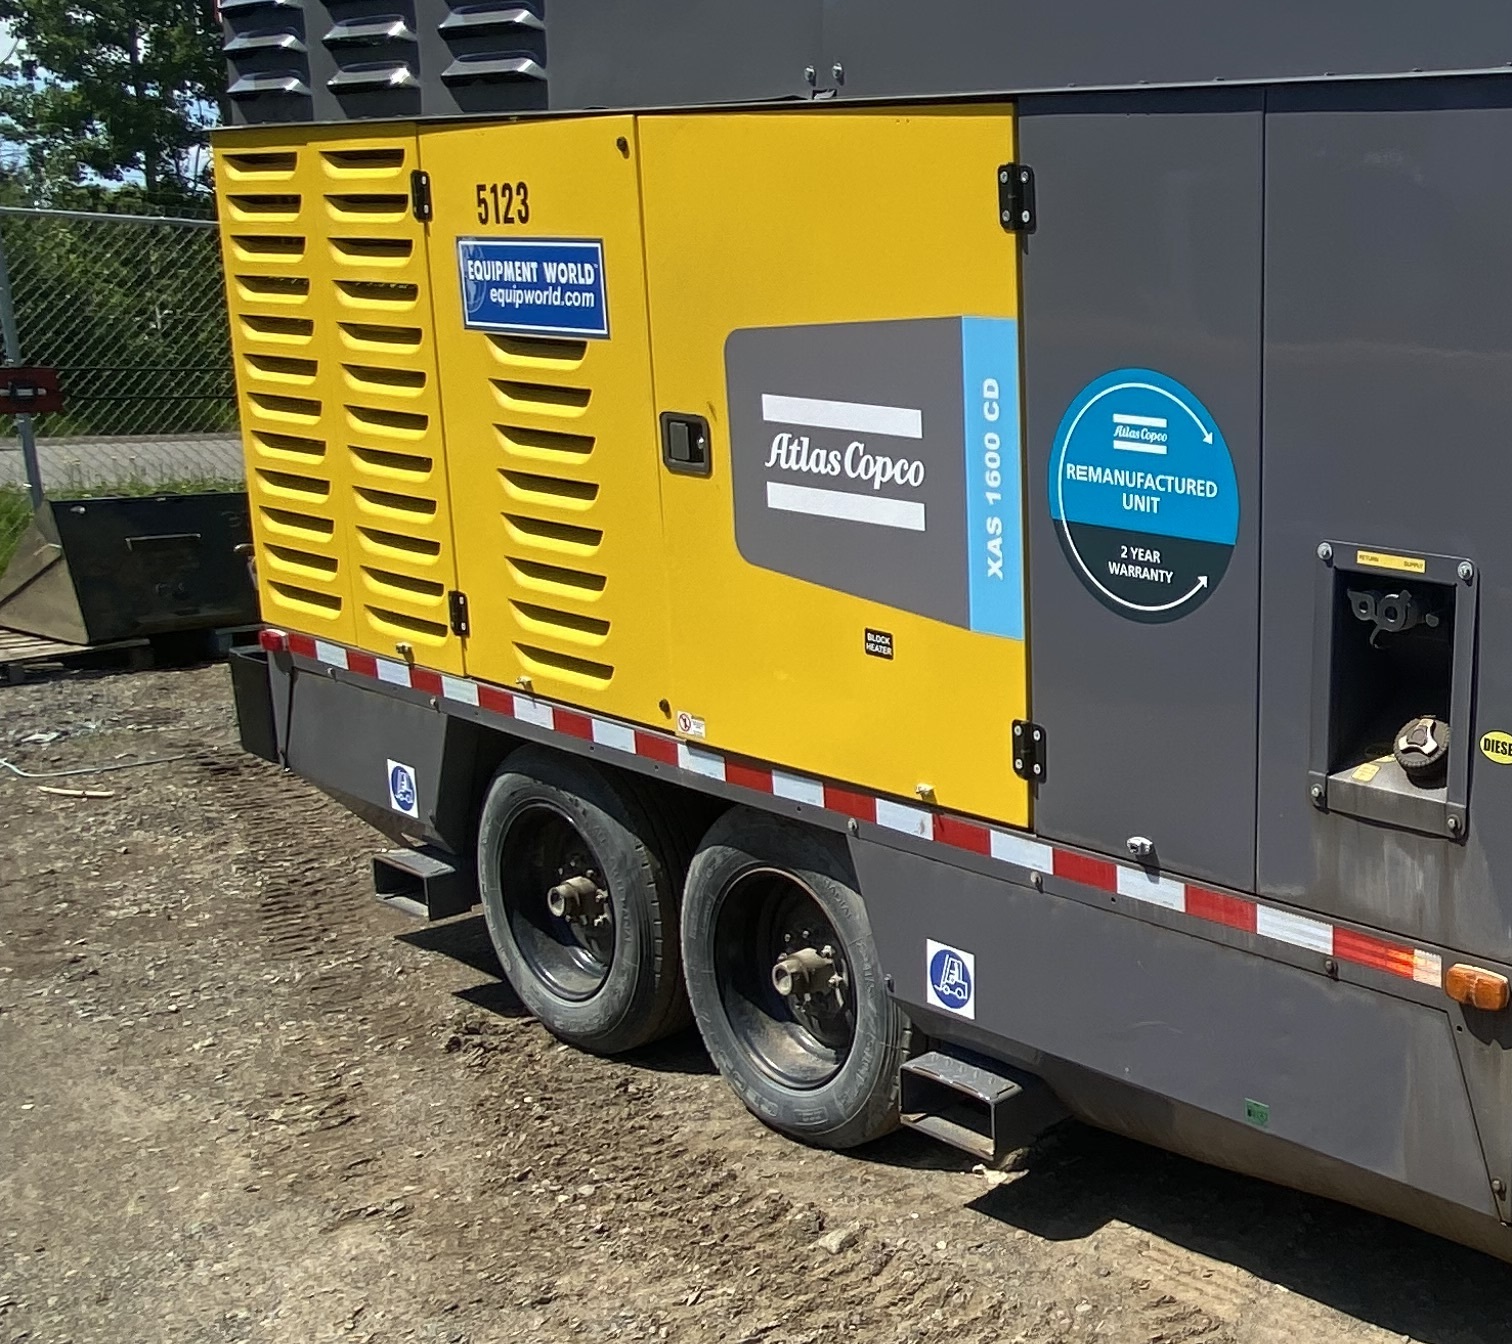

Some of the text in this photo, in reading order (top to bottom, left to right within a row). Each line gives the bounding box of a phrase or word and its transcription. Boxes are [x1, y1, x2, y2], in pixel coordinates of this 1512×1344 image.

[476, 181, 529, 225] 5123
[467, 260, 595, 285] EQUIPMENT WORLD
[490, 284, 595, 308] equipworld.com
[765, 432, 925, 490] Atlas Copco
[983, 378, 1003, 580] XAS 1600 CD
[1066, 463, 1218, 498] REMANUFACTURED
[1122, 493, 1161, 514] UNIT
[1120, 546, 1161, 564] 2 YEAR
[1108, 561, 1173, 584] WARRANTY
[866, 642, 892, 656] HEATER
[867, 632, 890, 645] BLOCK
